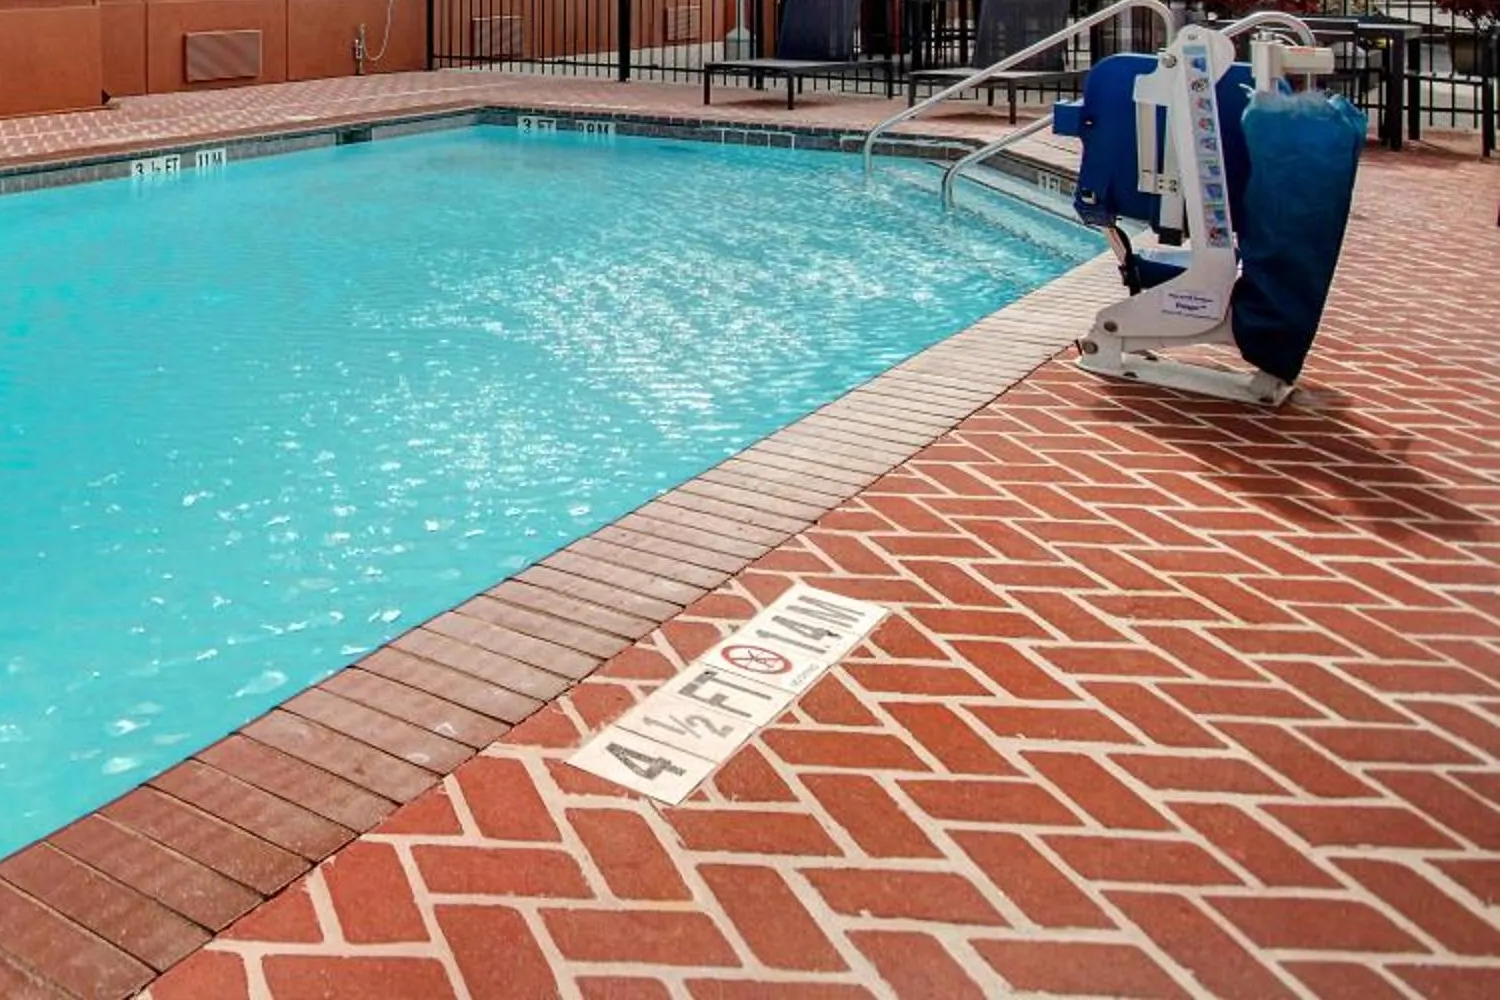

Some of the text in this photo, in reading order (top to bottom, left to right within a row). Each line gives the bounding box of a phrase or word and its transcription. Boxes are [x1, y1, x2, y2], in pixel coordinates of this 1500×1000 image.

[165, 156, 179, 173] FT
[605, 741, 687, 780] 4
[679, 670, 772, 719] FT
